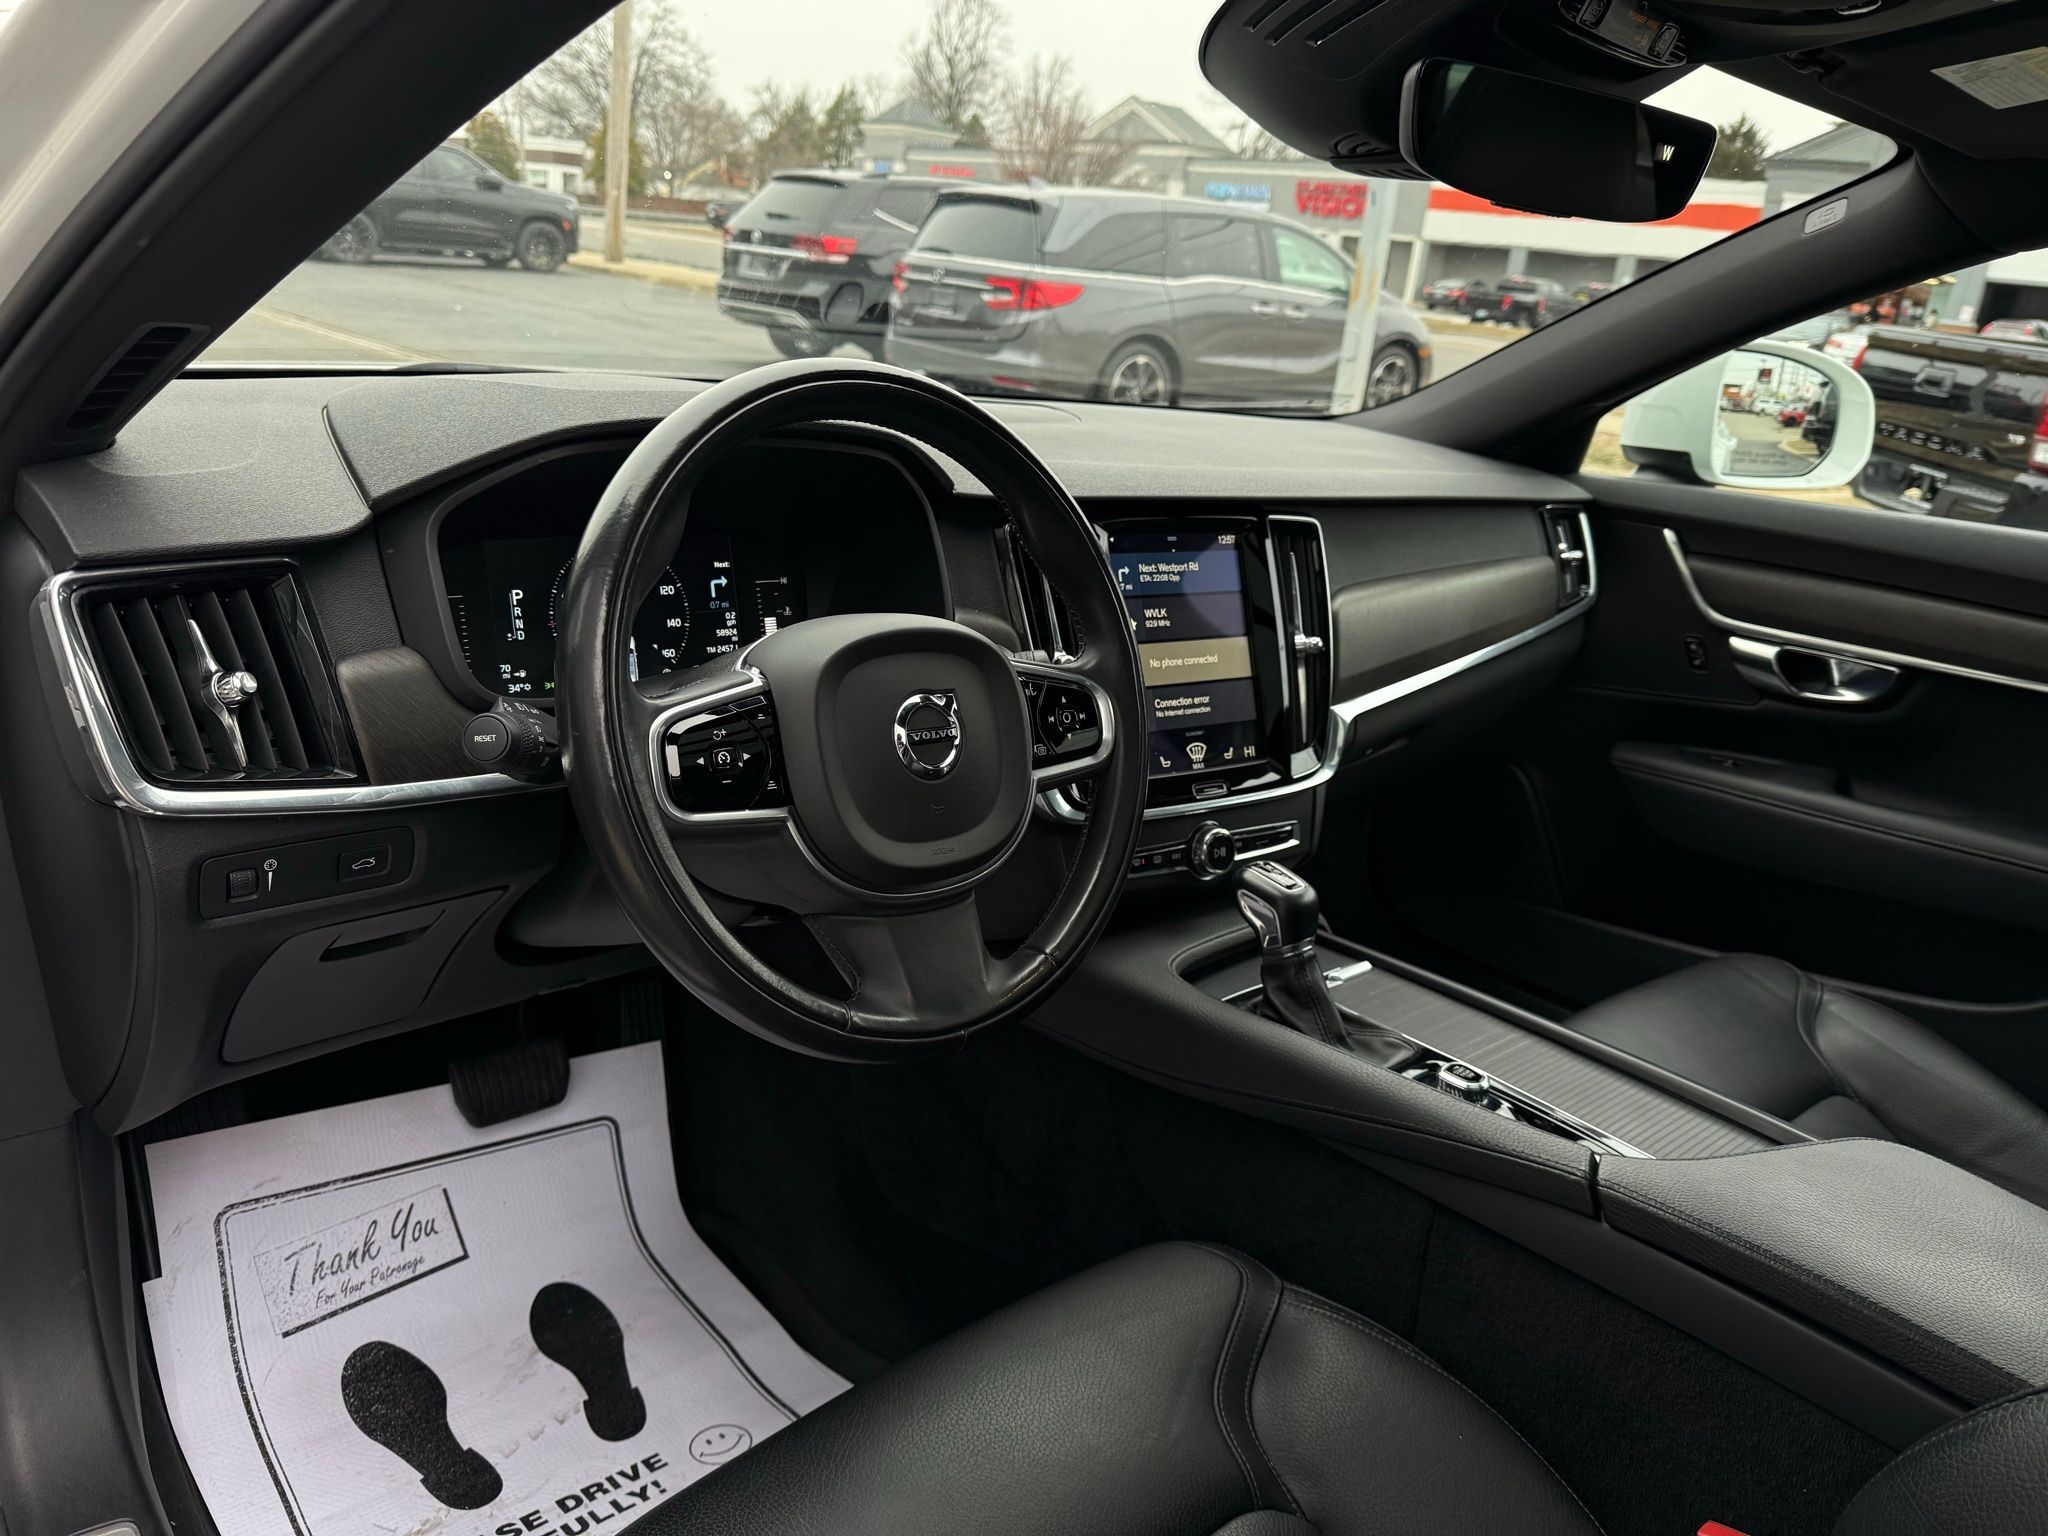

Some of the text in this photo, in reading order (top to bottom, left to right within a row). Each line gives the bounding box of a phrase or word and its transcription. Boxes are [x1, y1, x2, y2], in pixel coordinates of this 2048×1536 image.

[1662, 144, 1675, 161] W
[1138, 562, 1199, 574] Next: Westport Rd
[660, 585, 675, 595] 120
[511, 589, 523, 605] P
[710, 601, 720, 609] 0.7
[514, 607, 522, 616] R
[1144, 608, 1167, 618] WVLK
[515, 619, 524, 629] N
[667, 618, 682, 627] 140
[516, 631, 525, 640] D
[716, 628, 737, 637] 58924
[1149, 654, 1218, 669] No phone connected
[500, 664, 511, 673] 70
[1154, 695, 1210, 708] Connection error
[1155, 710, 1165, 718] No
[1185, 706, 1211, 715] connection
[474, 734, 497, 743] RESET
[910, 727, 957, 741] VOLVO
[1243, 745, 1256, 758] HI
[284, 1202, 438, 1297] Thank You
[316, 1255, 425, 1309] For Your Patronage
[555, 1452, 669, 1514] DRIVE
